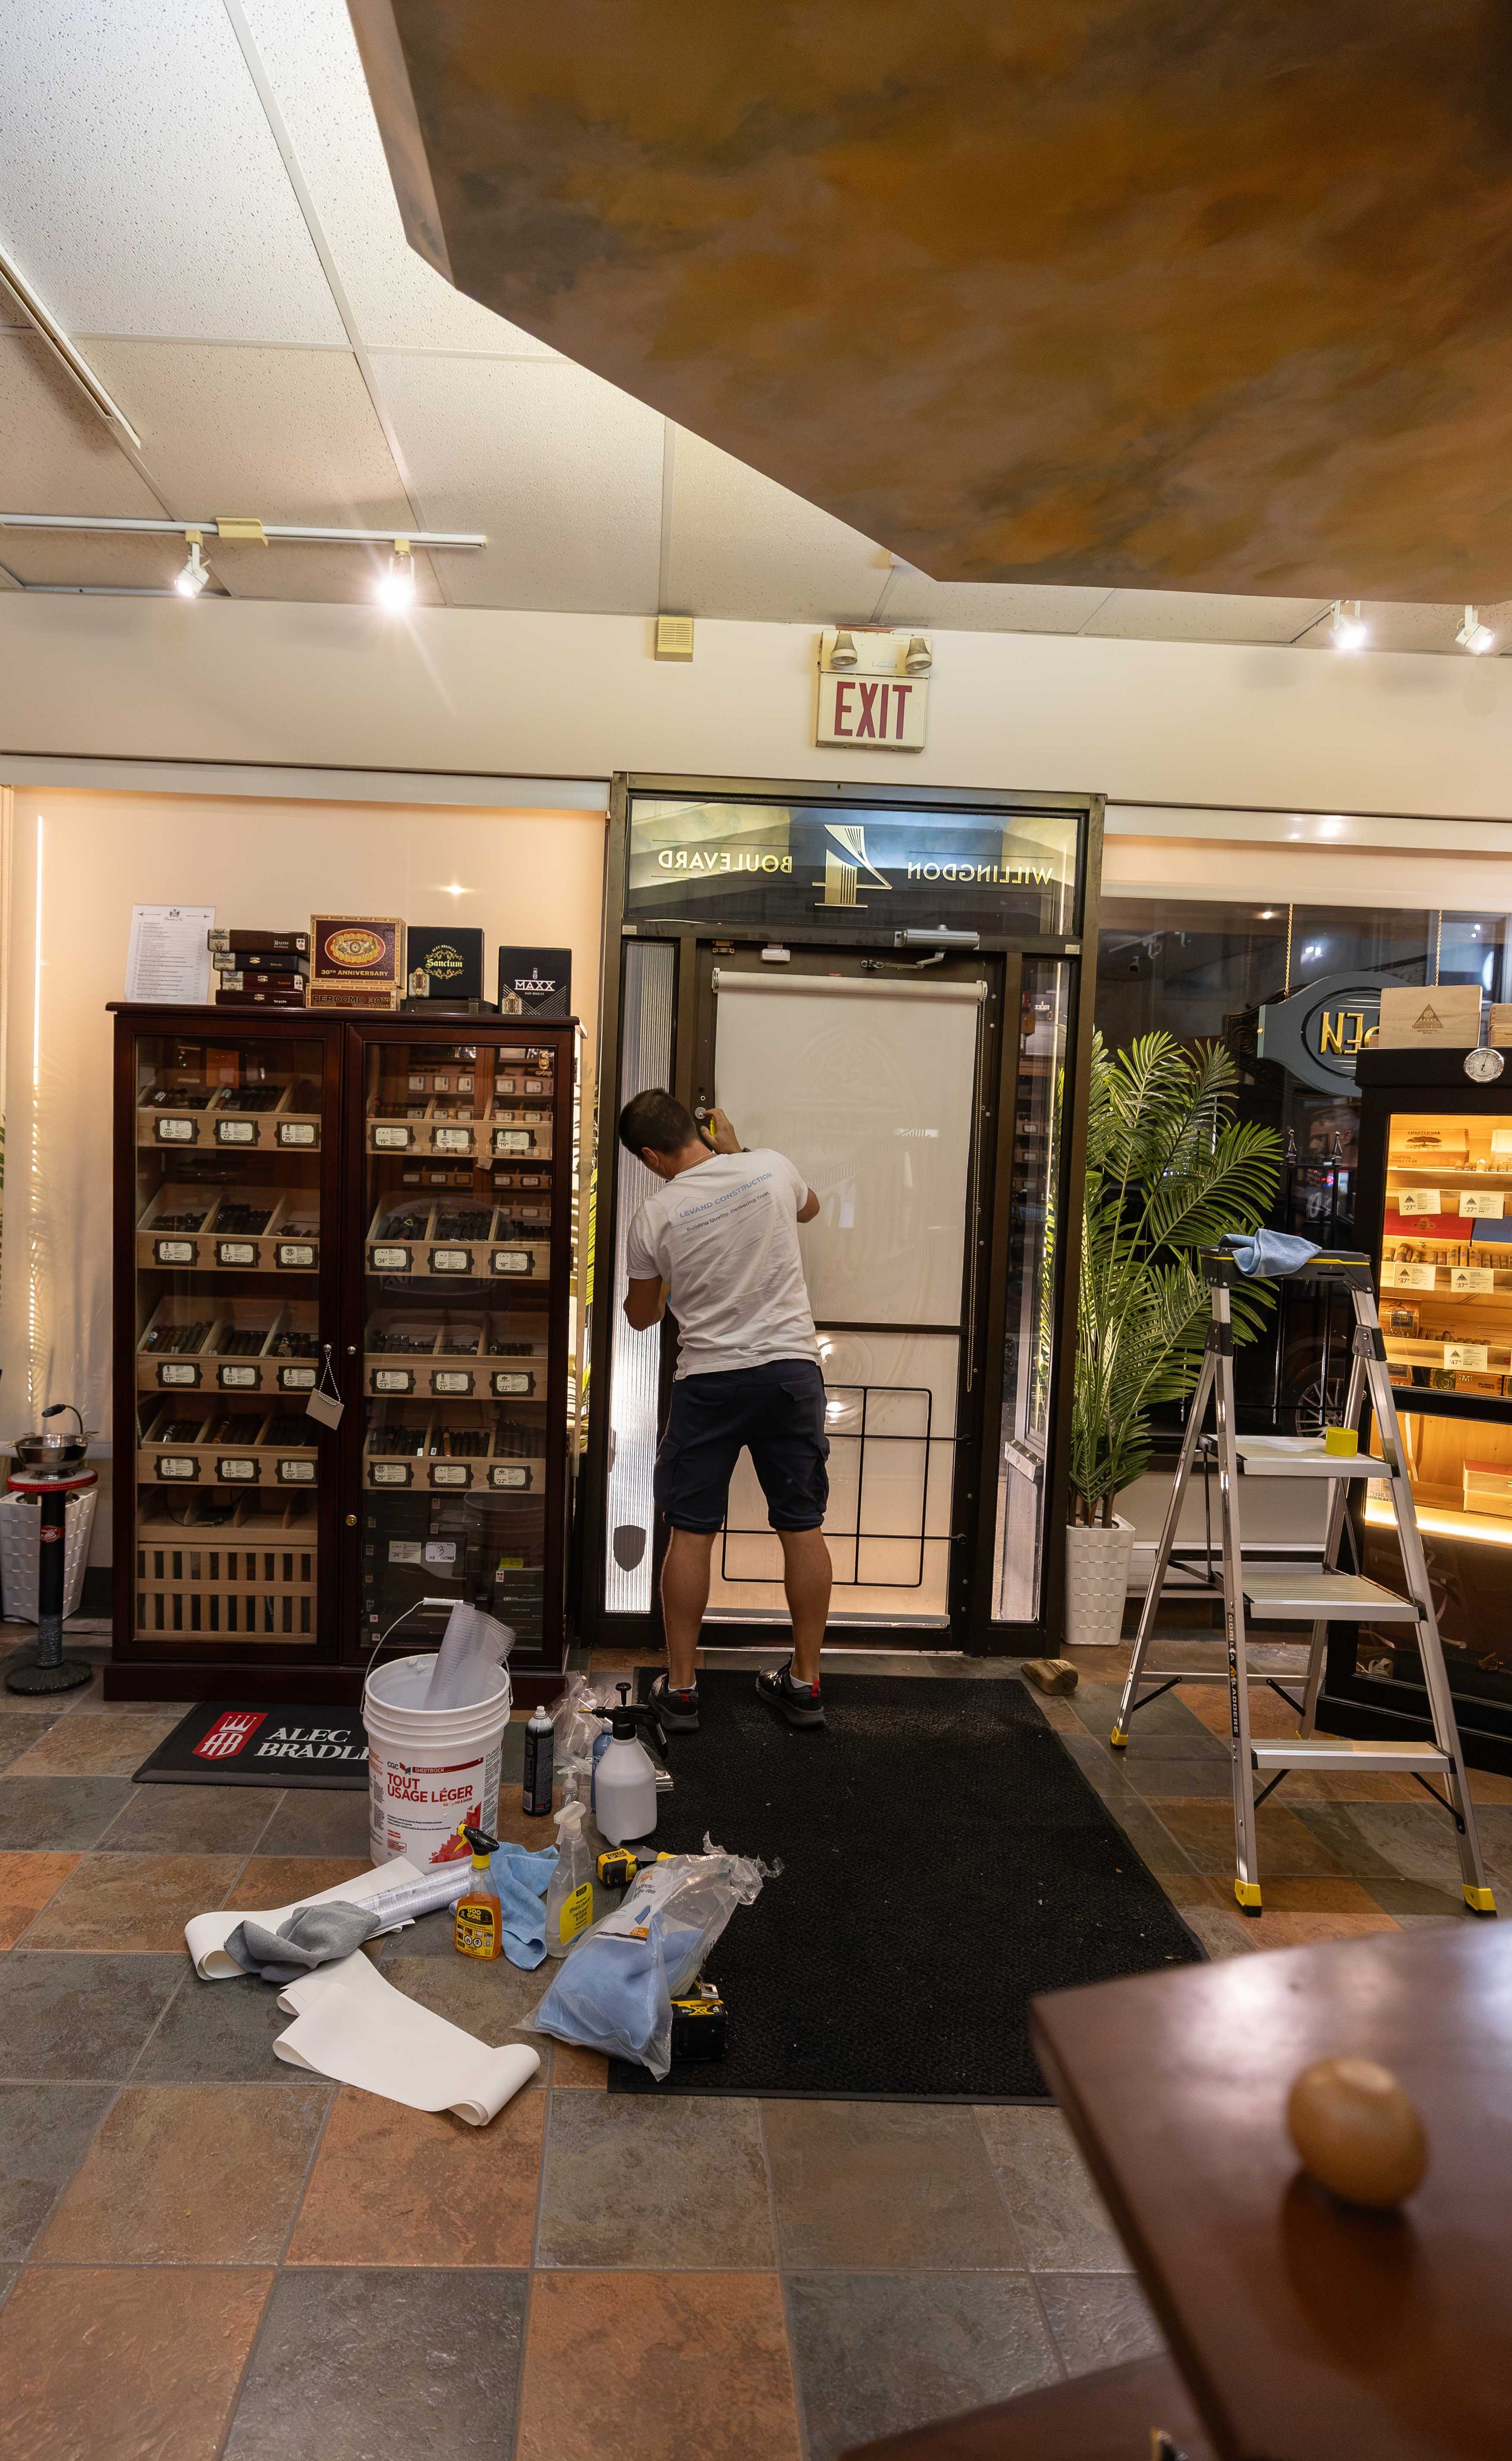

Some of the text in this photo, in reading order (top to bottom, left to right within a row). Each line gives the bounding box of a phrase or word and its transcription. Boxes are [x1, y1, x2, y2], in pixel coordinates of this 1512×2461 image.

[834, 680, 913, 740] EXIT
[425, 958, 463, 968] Sanctum
[514, 979, 556, 992] MAXX
[313, 994, 365, 1003] PERDOMO
[679, 1172, 773, 1219] LEVAND CONSTRUCTION
[686, 1220, 709, 1232] Building
[730, 1198, 757, 1214] Delivering
[438, 1545, 445, 1557] 3
[1228, 1614, 1237, 1662] GORILLA
[1231, 1681, 1239, 1734] LADDERS
[264, 1727, 352, 1743] ALEC
[387, 1761, 399, 1770] CGC
[386, 1772, 421, 1790] TOUT
[387, 1784, 474, 1803] USAGE LÉGER
[466, 1912, 481, 1921] GONE
[467, 1907, 481, 1915] GOO
